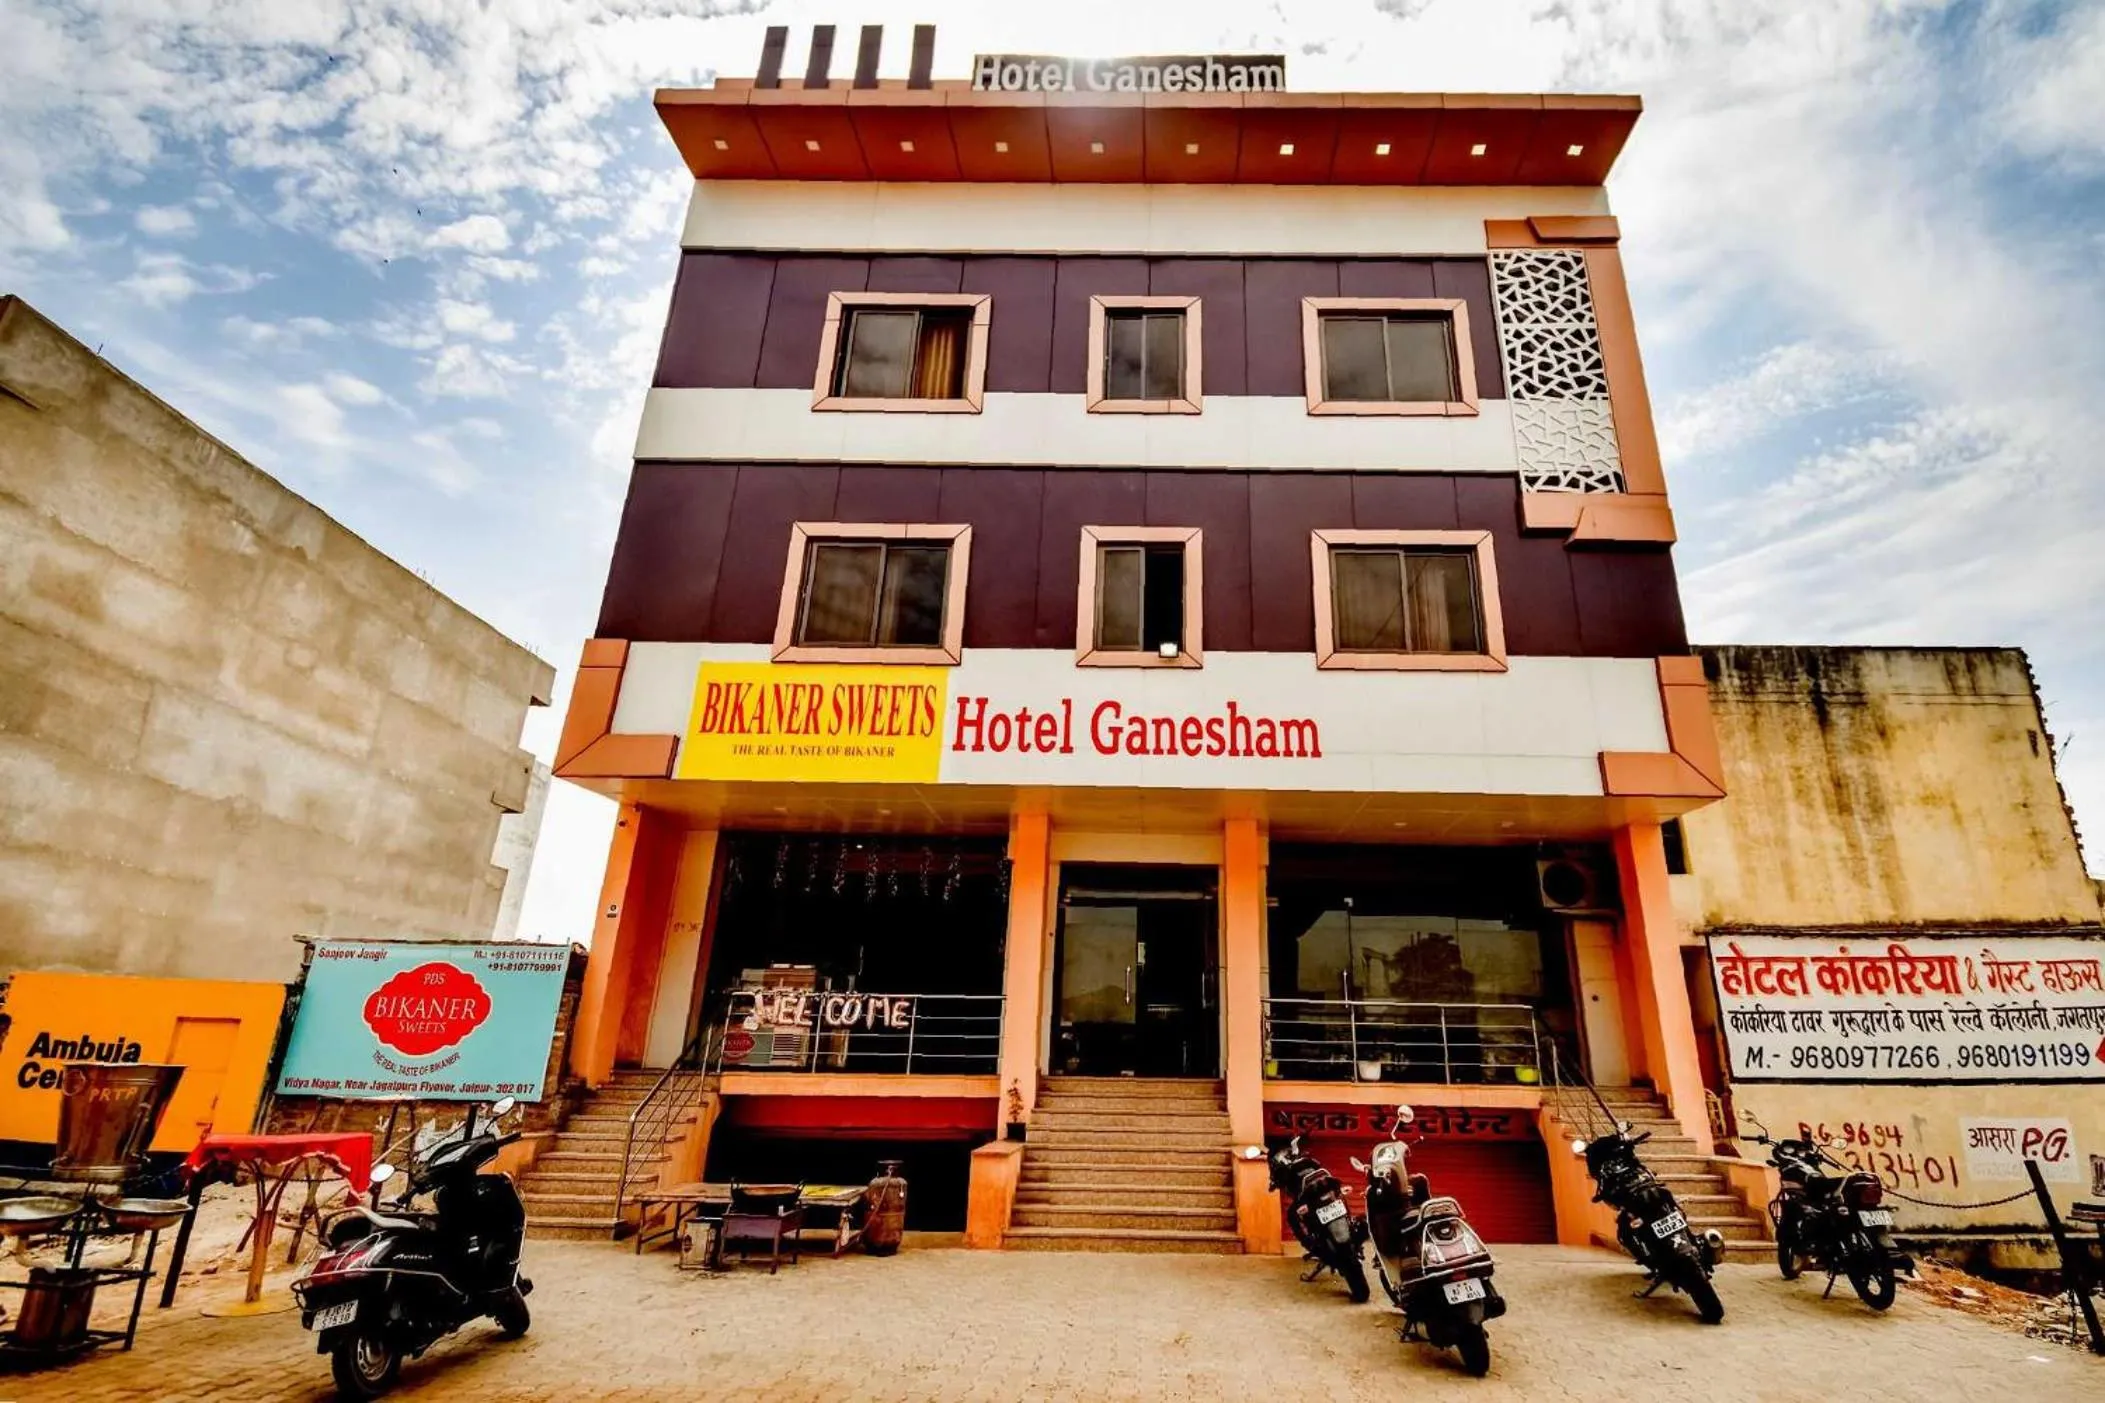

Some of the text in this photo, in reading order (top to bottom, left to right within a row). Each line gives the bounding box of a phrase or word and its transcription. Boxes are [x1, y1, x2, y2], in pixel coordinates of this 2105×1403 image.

[971, 55, 1286, 92] Hotel Ganesham
[699, 682, 938, 738] BIKANER SWEETS
[952, 697, 1322, 758] Hotel Ganesham
[732, 744, 895, 758] THE REAL TASTE OF BIKANER
[424, 973, 446, 985] PDS
[1716, 942, 1810, 996] होटल
[1809, 944, 1962, 996] कांकरिया
[374, 996, 477, 1020] BIKANER
[1728, 1002, 1788, 1034] कांकरिया
[1789, 1009, 1826, 1034] टावर
[1885, 1002, 1905, 1032] के
[1907, 1009, 1946, 1032] पास
[398, 1021, 447, 1033] SWEETS
[26, 1032, 142, 1063] Ambuja
[1957, 1042, 2091, 1068] 9680191199
[284, 1077, 309, 1089] Vidya
[311, 1078, 342, 1091] Nagar,
[345, 1080, 368, 1090] Near
[496, 1083, 514, 1094] 302
[516, 1083, 536, 1095] 017
[1968, 1126, 2070, 1163] आसरा P.G.
[1657, 1218, 1684, 1237] 9023
